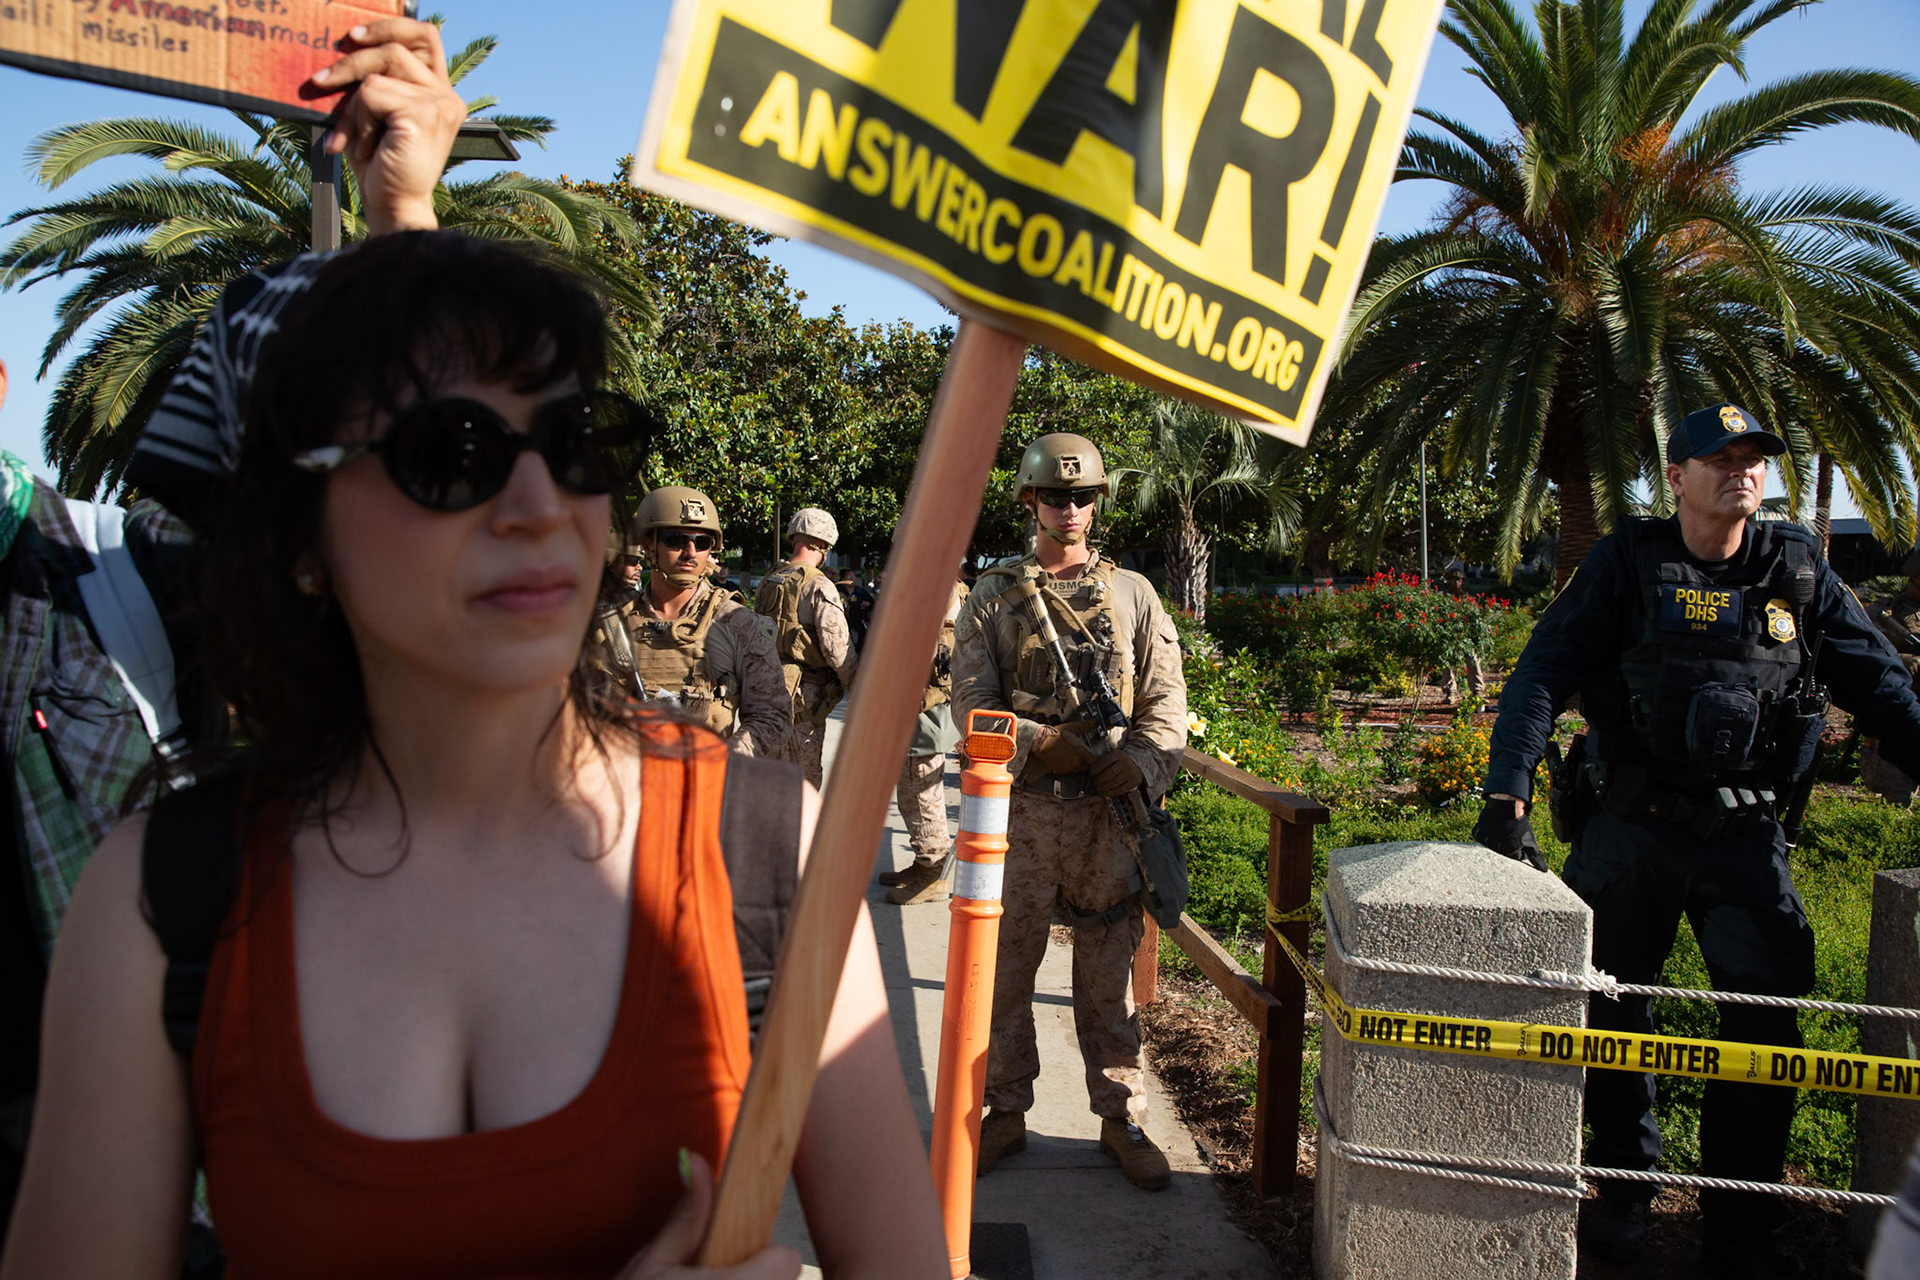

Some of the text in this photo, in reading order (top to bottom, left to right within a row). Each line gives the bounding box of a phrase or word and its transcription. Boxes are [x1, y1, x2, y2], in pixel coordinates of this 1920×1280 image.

[81, 18, 188, 52] missiles
[738, 69, 1304, 393] ANSWERCOALITION.ORG
[1675, 588, 1731, 608] POLICE
[1684, 604, 1718, 622] DHS
[1359, 1015, 1407, 1042] NOT
[1414, 1020, 1492, 1053] ENTER
[1539, 1031, 1574, 1060] DO
[1582, 1035, 1632, 1066] NOT
[1639, 1040, 1720, 1075] ENTER
[1770, 1052, 1807, 1083] DO
[1815, 1057, 1869, 1089] NOT
